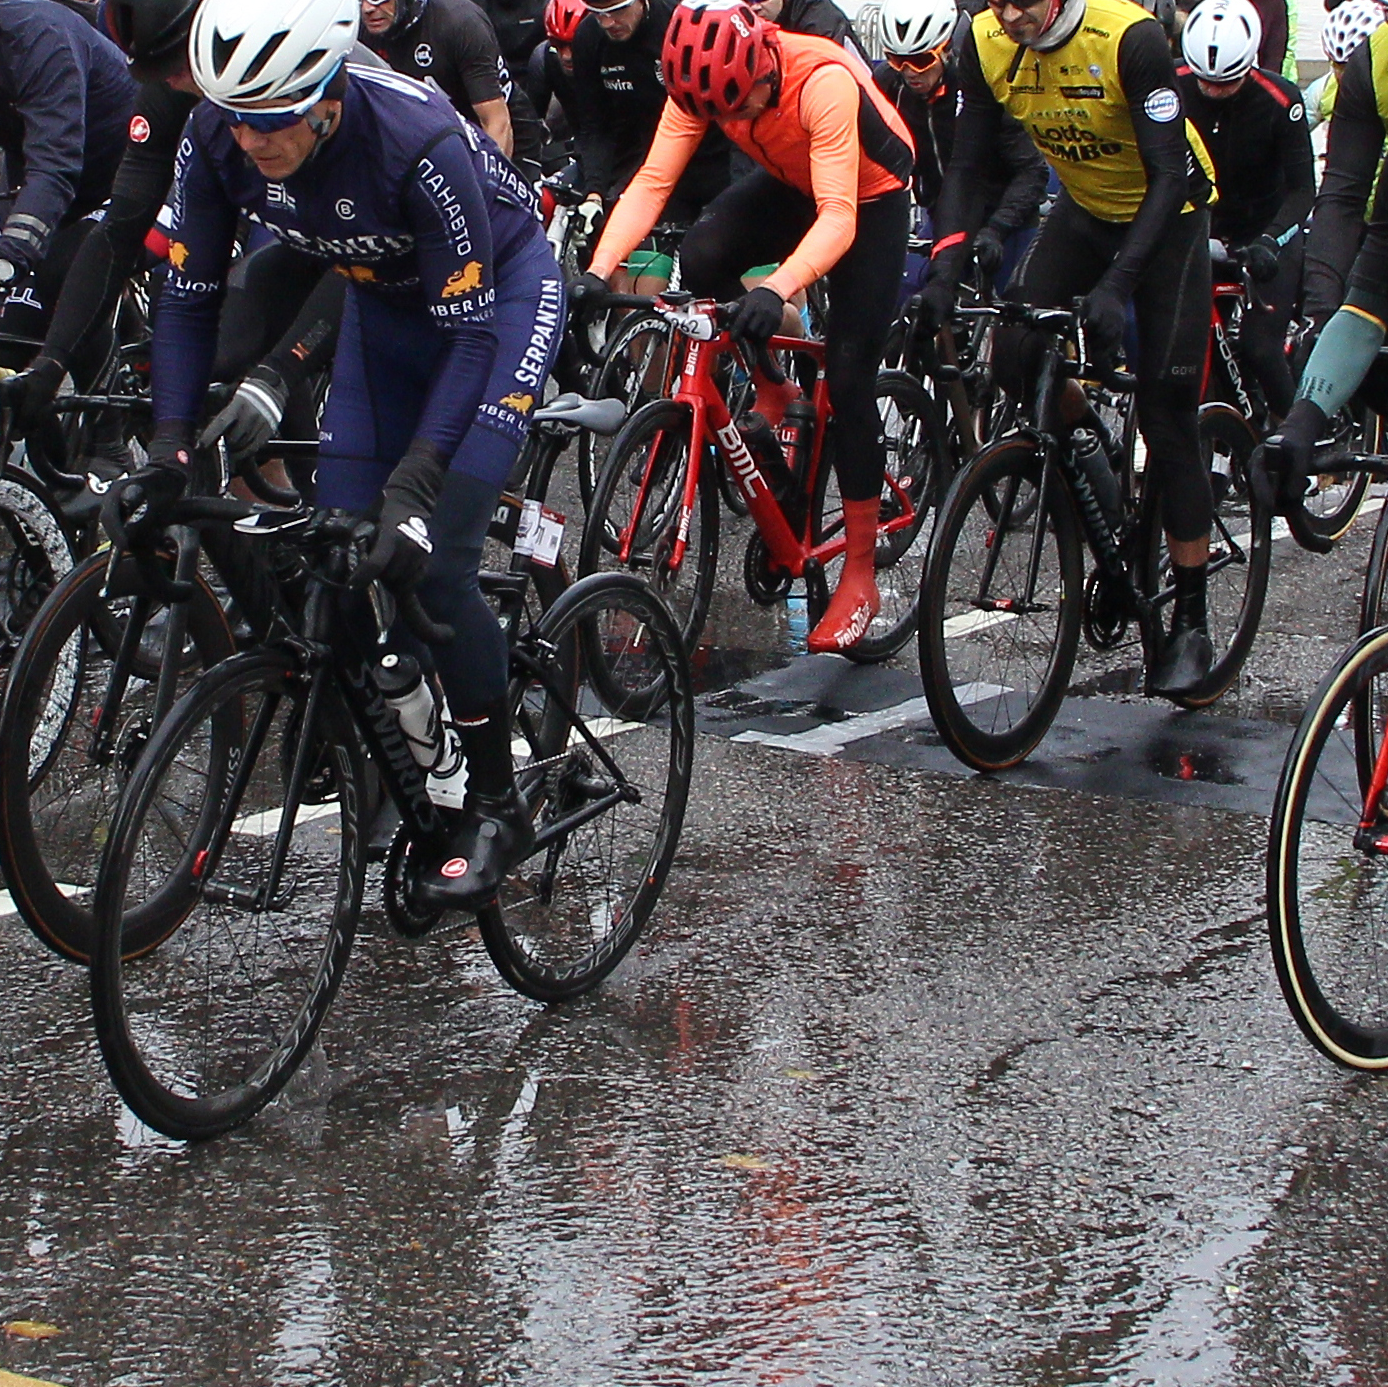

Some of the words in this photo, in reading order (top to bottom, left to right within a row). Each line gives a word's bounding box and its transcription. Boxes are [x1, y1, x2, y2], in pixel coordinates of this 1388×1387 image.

[418, 158, 472, 256] ПАНАВТО
[514, 279, 558, 387] SERPANTIN
[685, 340, 700, 377] BMC
[717, 418, 769, 499] BMC
[677, 505, 692, 543] BMC
